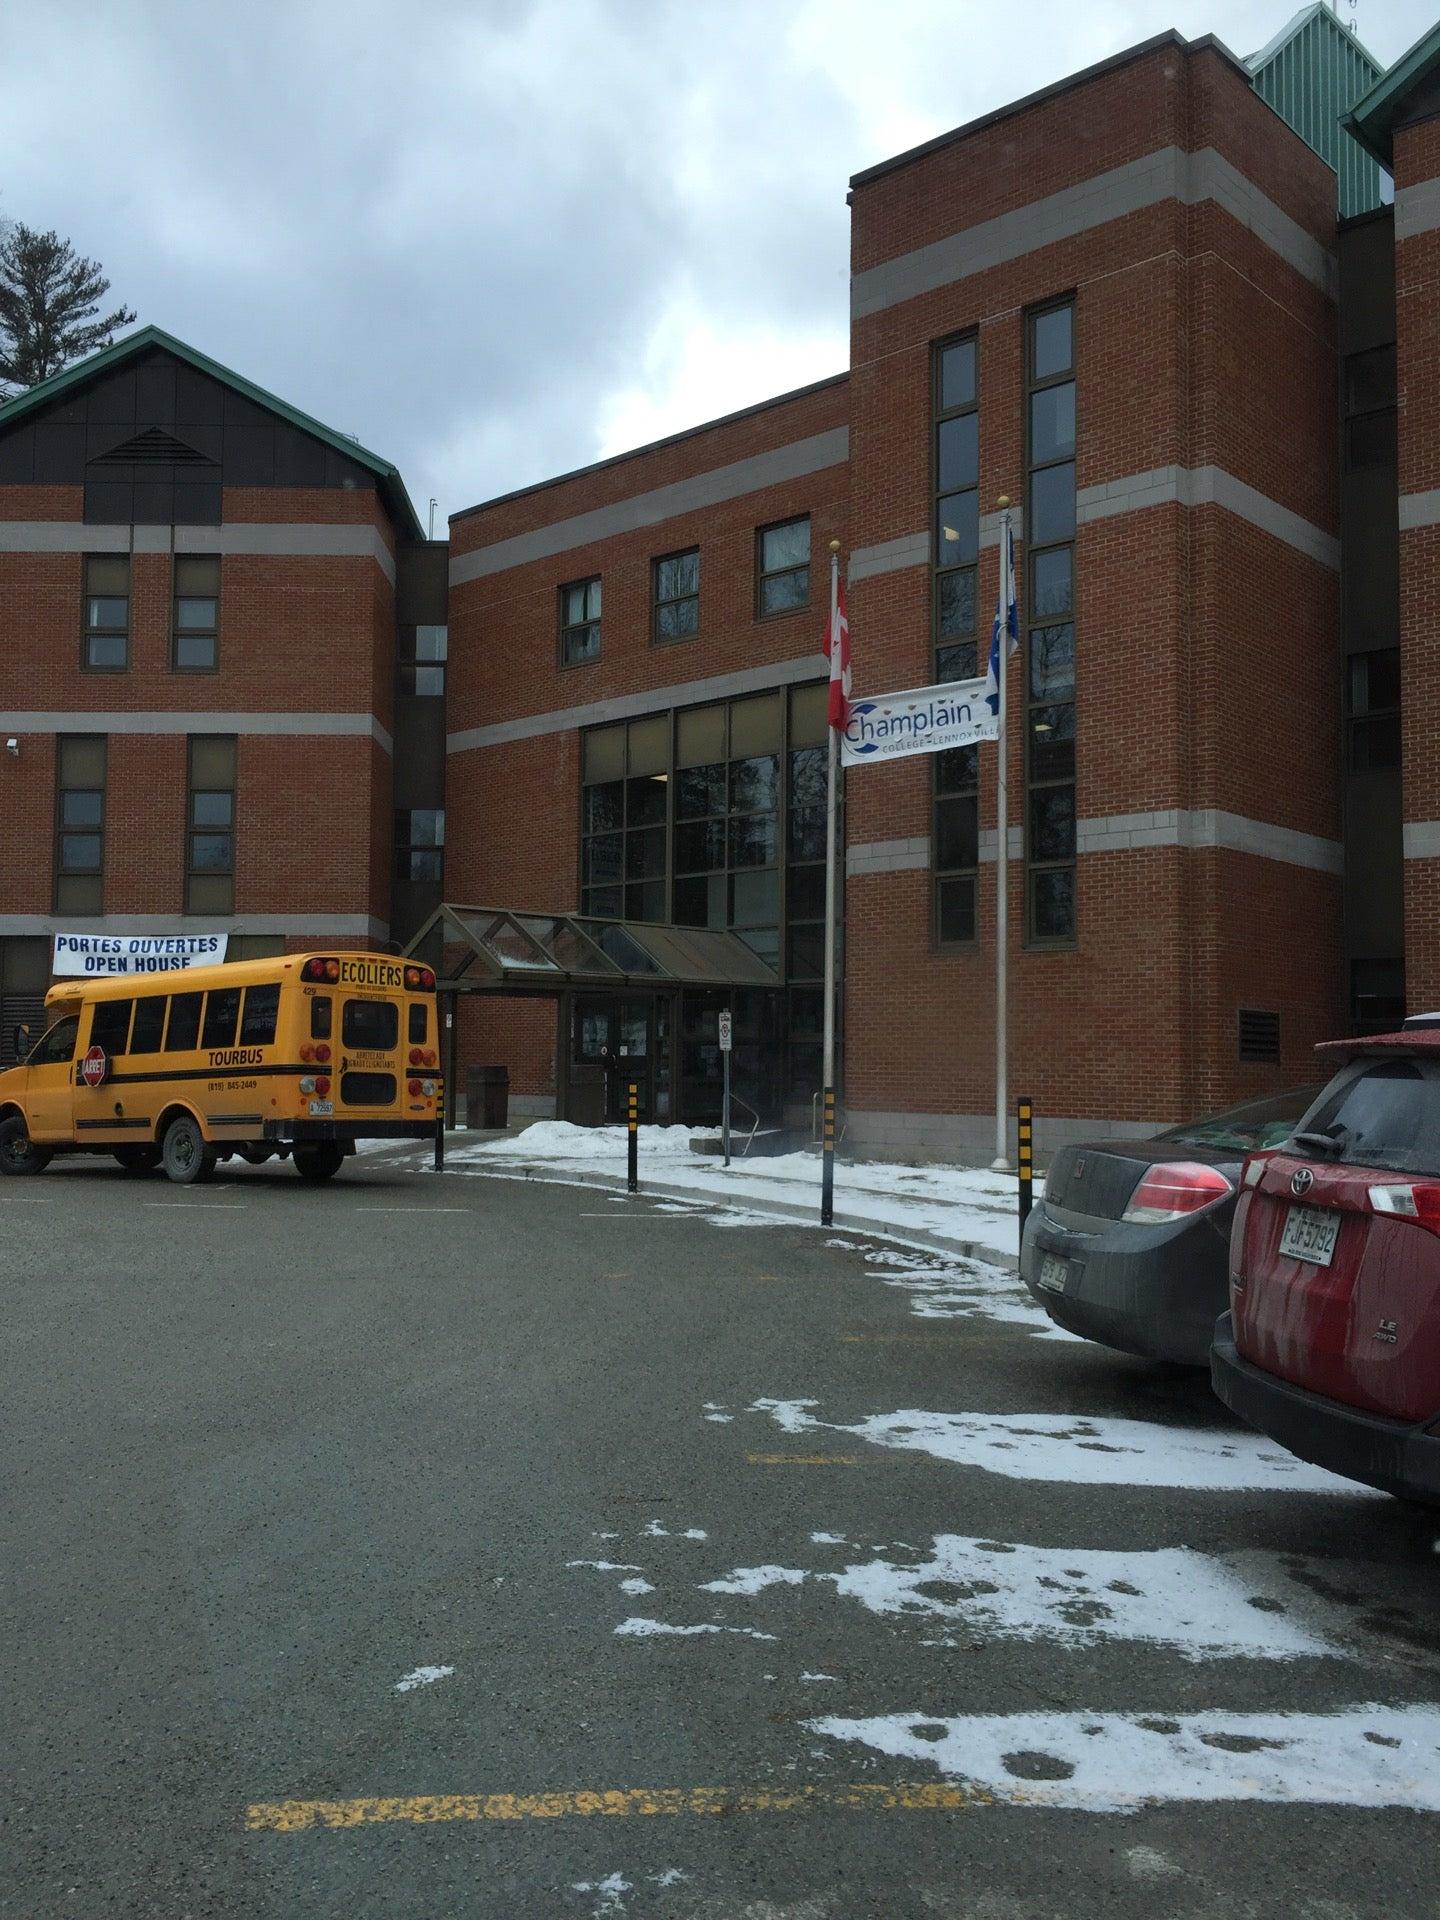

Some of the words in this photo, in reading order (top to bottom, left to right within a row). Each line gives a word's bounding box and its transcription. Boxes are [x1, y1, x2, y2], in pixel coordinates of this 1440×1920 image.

[844, 700, 972, 742] Champlain
[57, 937, 121, 953] PORTES
[129, 937, 218, 954] OUVERTES
[85, 956, 128, 972] OPEN
[341, 962, 402, 987] ECOLIERS
[209, 1049, 263, 1066] TOURBUS
[1379, 1319, 1397, 1331] LE
